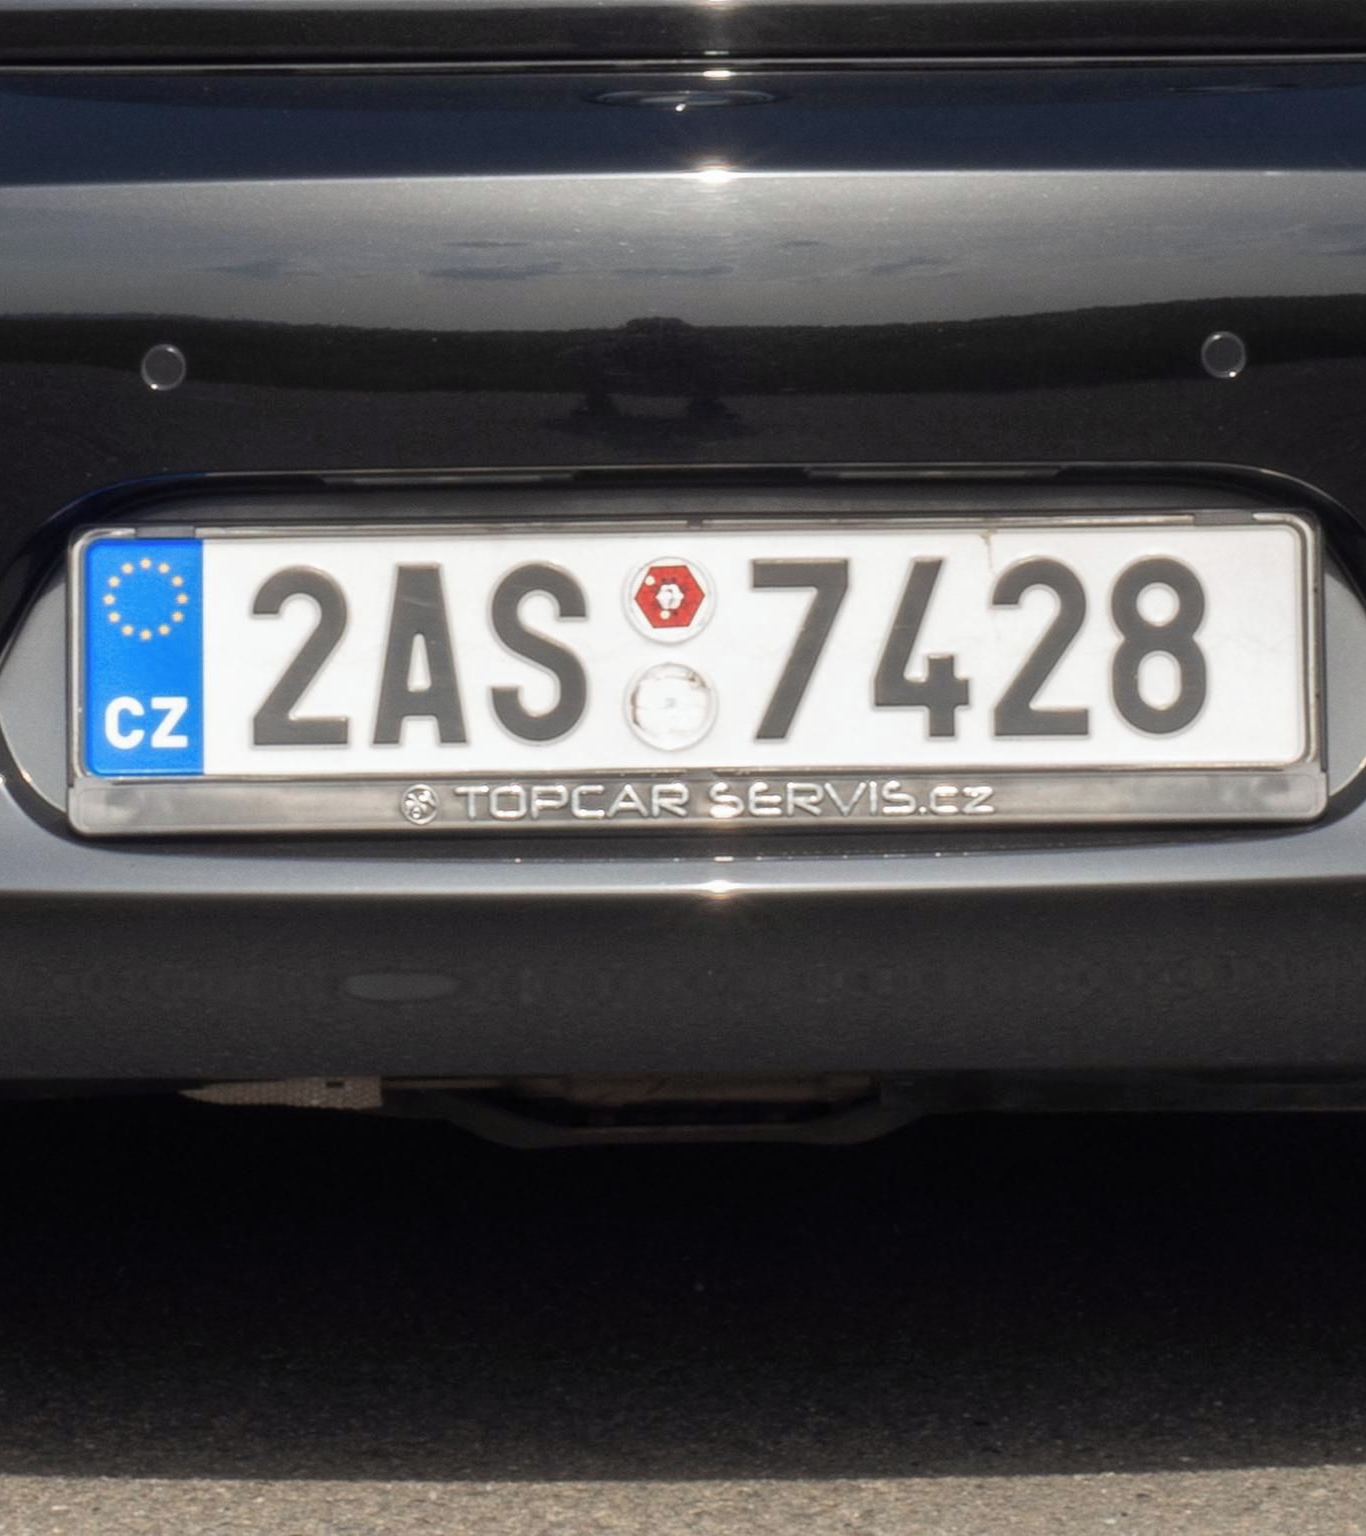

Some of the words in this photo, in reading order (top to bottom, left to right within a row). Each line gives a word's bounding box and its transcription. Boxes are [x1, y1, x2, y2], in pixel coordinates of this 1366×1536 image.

[104, 695, 189, 750] CZ
[250, 561, 588, 747] 2AS
[749, 557, 1208, 742] 7428
[454, 781, 691, 821] TOPCAR
